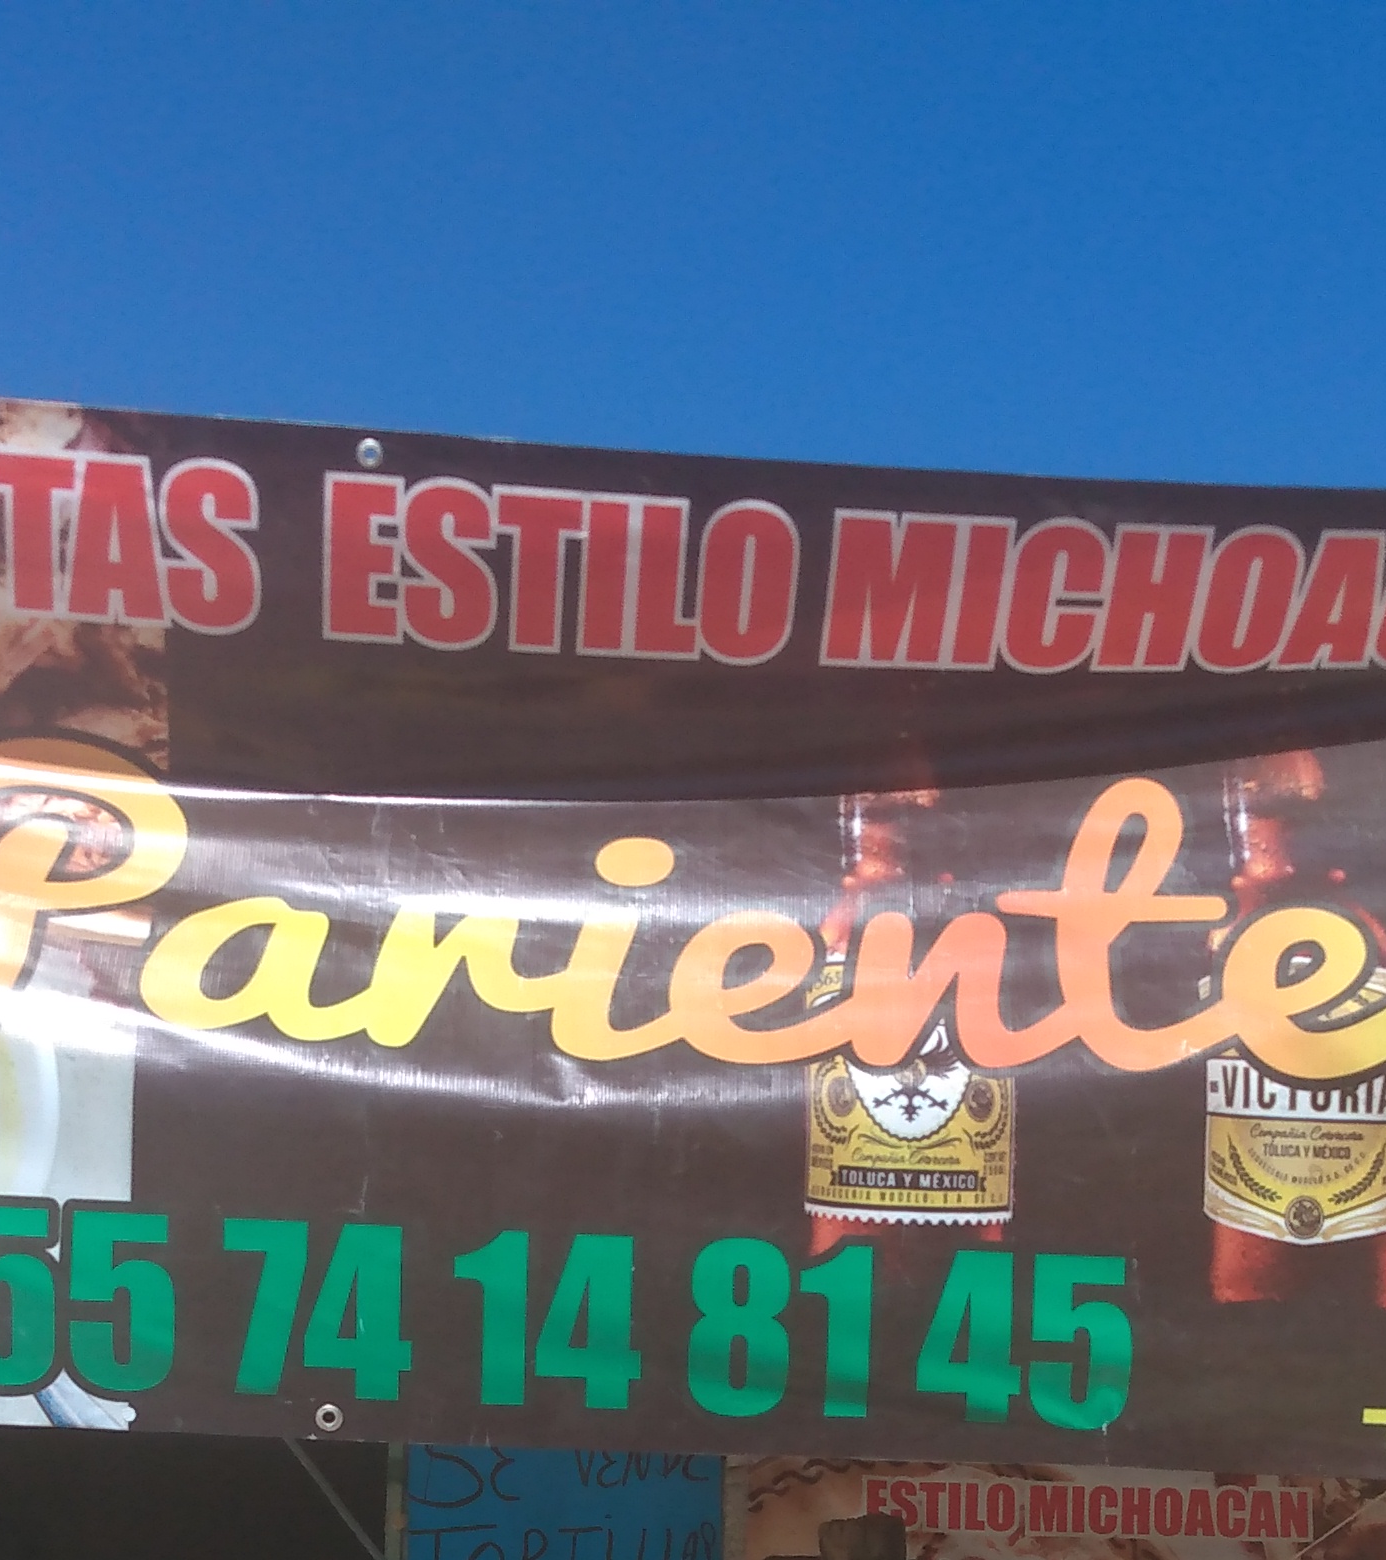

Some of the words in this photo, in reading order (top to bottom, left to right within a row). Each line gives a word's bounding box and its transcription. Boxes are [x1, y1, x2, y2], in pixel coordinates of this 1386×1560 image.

[327, 477, 797, 663] ESTILO
[840, 1168, 899, 1187] TOLUCA
[903, 1173, 914, 1188] Y
[919, 1171, 976, 1189] MÉXICO
[221, 1216, 413, 1402] 74
[452, 1228, 643, 1411] 14
[685, 1236, 876, 1419] 81
[914, 1249, 1135, 1430] 45
[865, 1479, 1017, 1533] ESTILO
[1028, 1484, 1310, 1539] MICHOACAN
